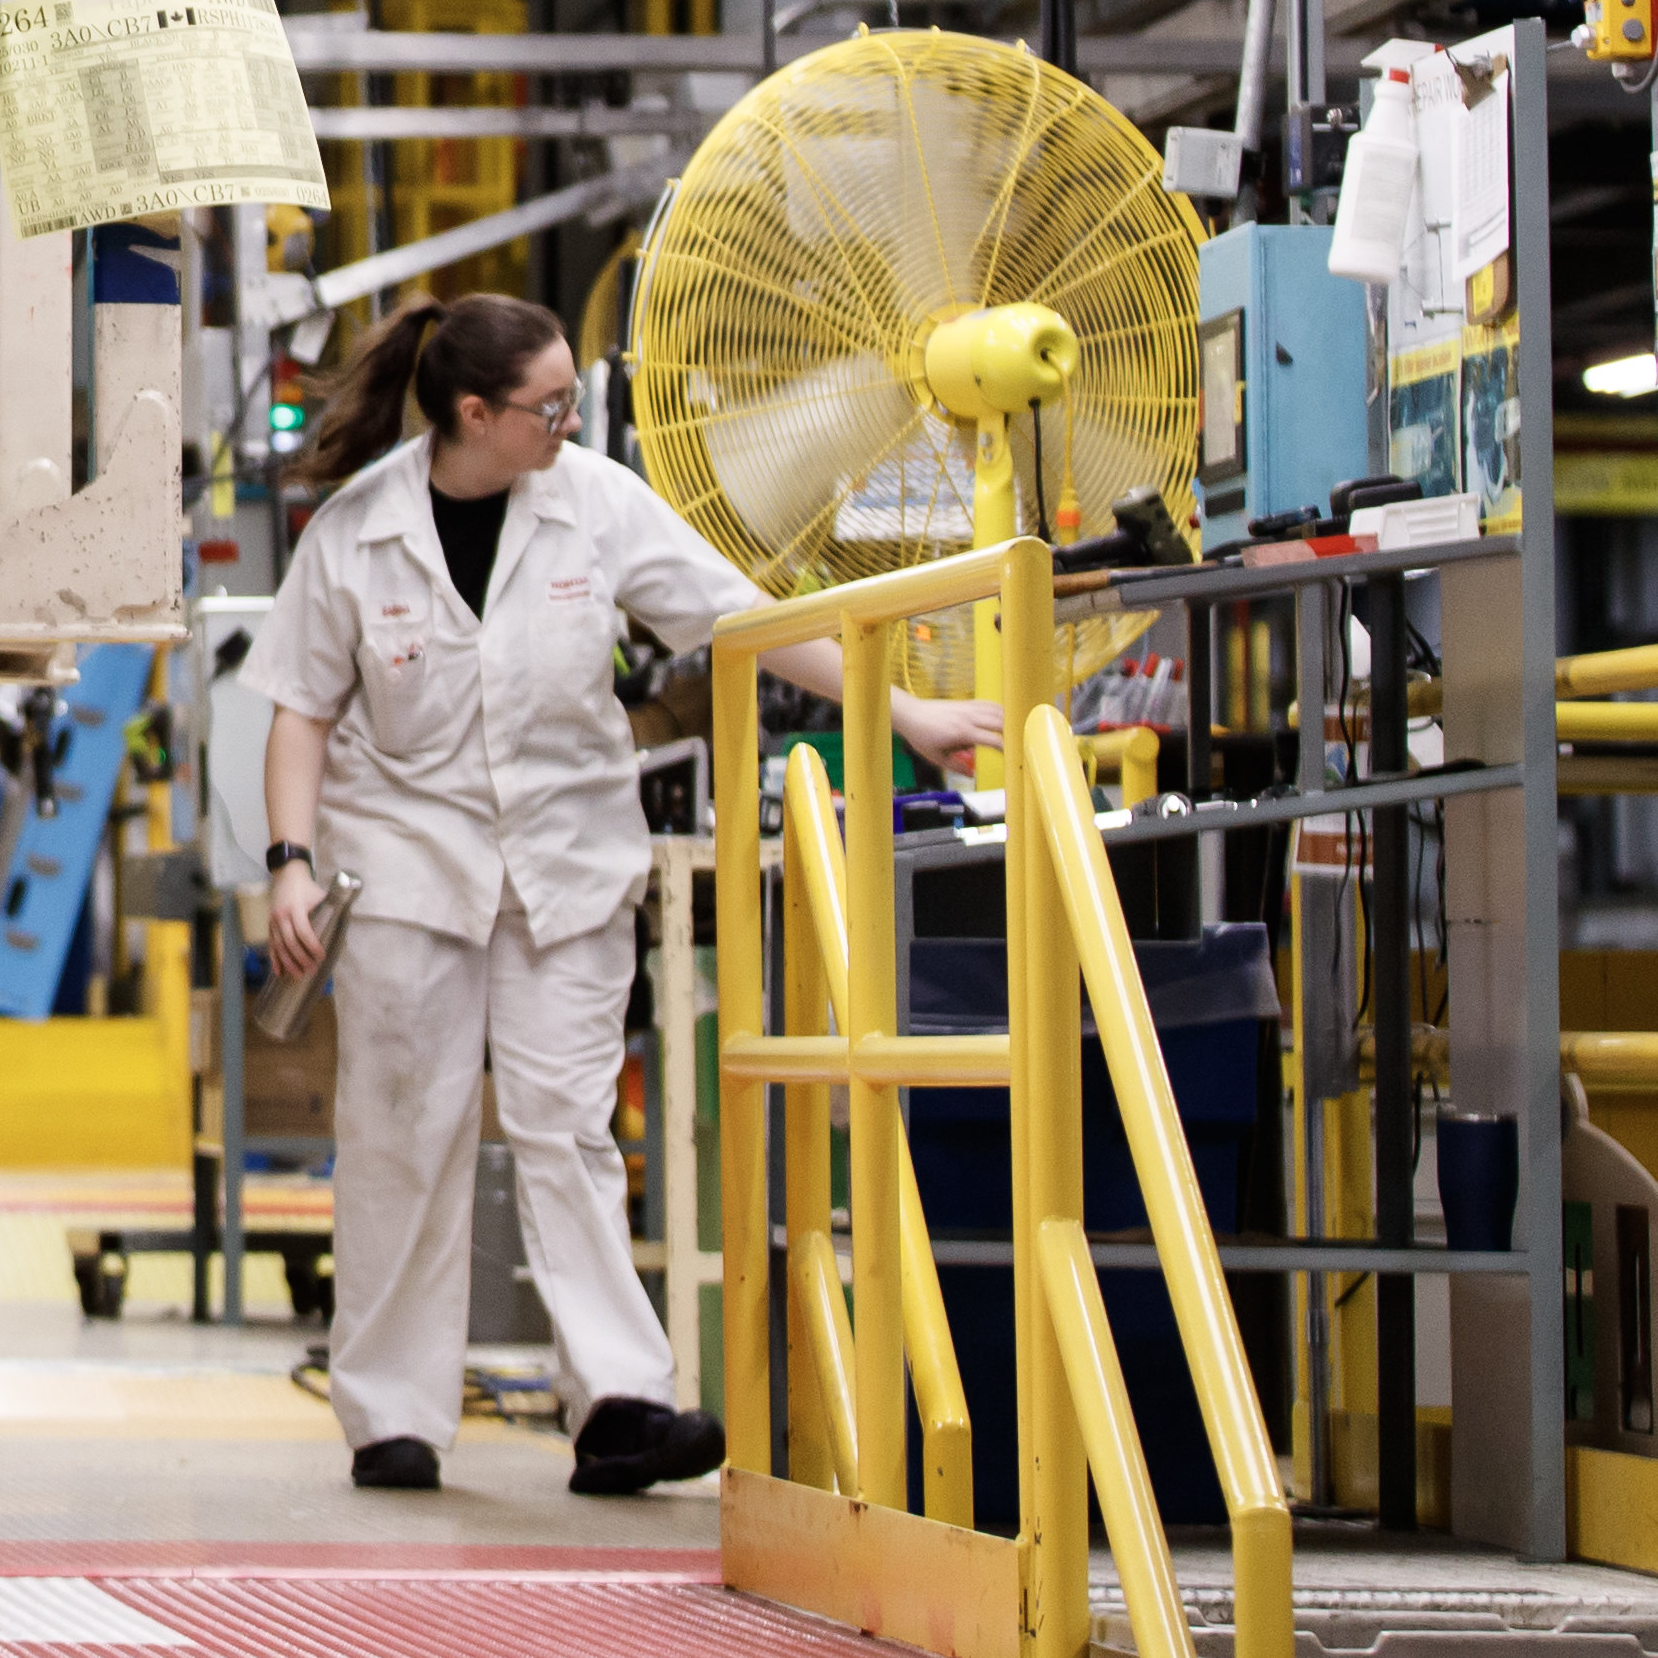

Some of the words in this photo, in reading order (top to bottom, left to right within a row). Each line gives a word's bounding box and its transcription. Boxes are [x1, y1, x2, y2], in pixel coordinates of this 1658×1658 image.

[50, 15, 152, 51] 3A0\CB7
[18, 199, 41, 216] UB
[79, 205, 116, 224] AWD
[136, 183, 234, 213] 3A0\CB7
[295, 185, 328, 206] 0264
